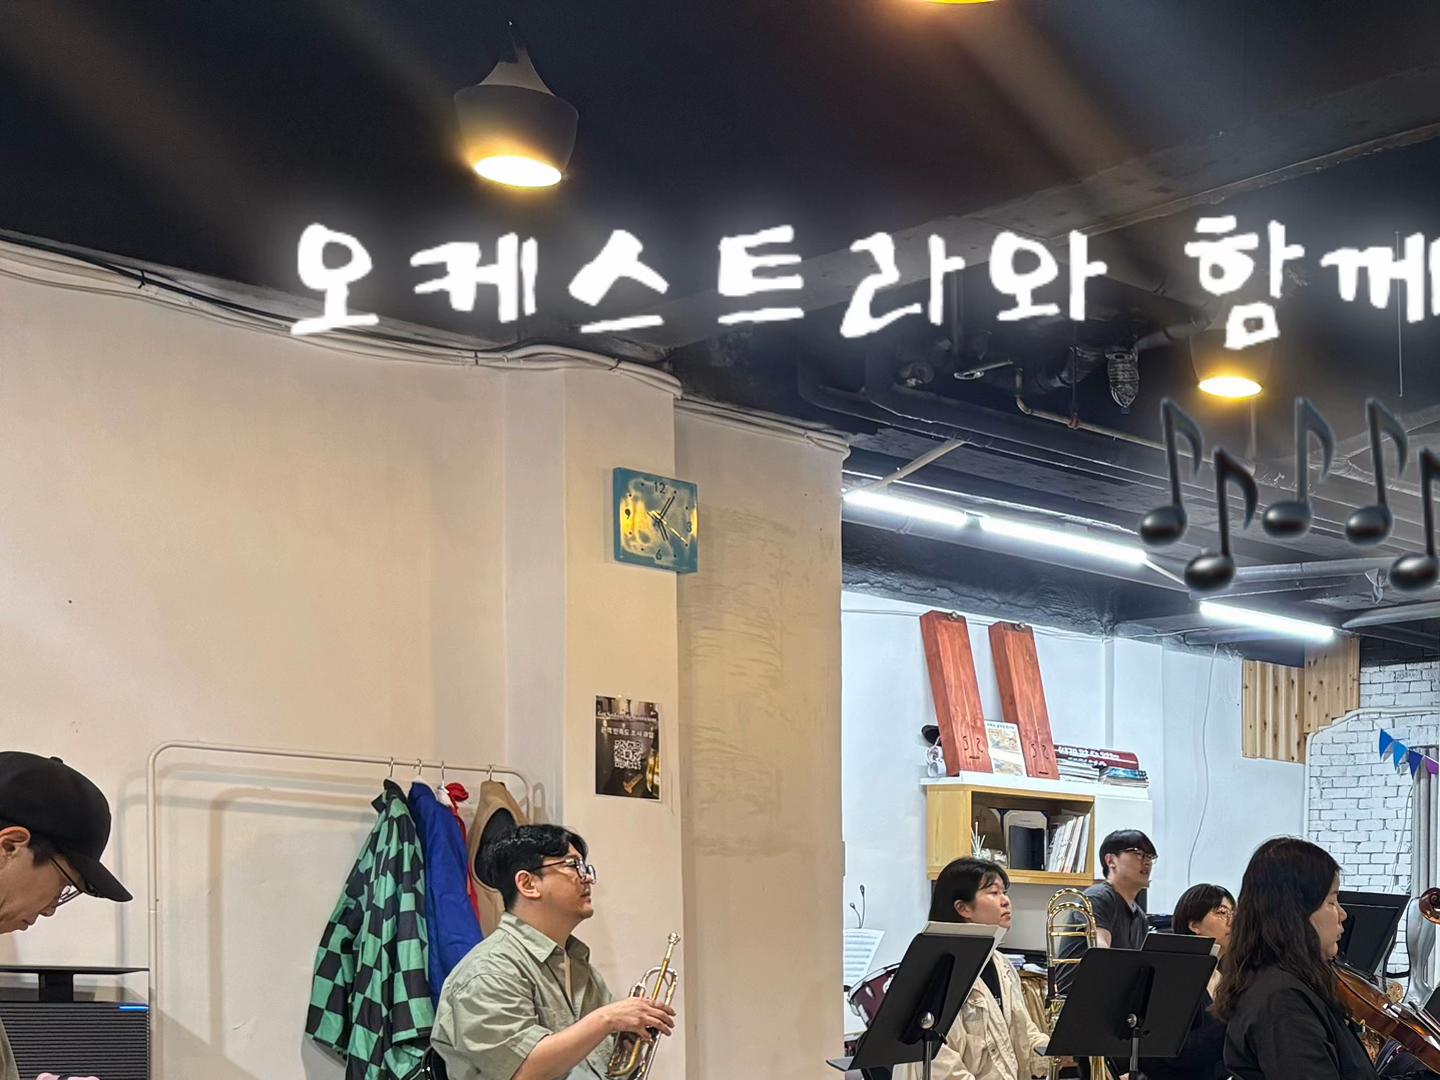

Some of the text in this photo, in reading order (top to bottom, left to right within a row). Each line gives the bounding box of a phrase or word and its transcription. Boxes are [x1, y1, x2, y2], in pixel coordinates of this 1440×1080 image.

[654, 481, 667, 495] 12
[624, 508, 631, 520] 9
[686, 521, 692, 533] 3
[655, 549, 662, 560] 6
